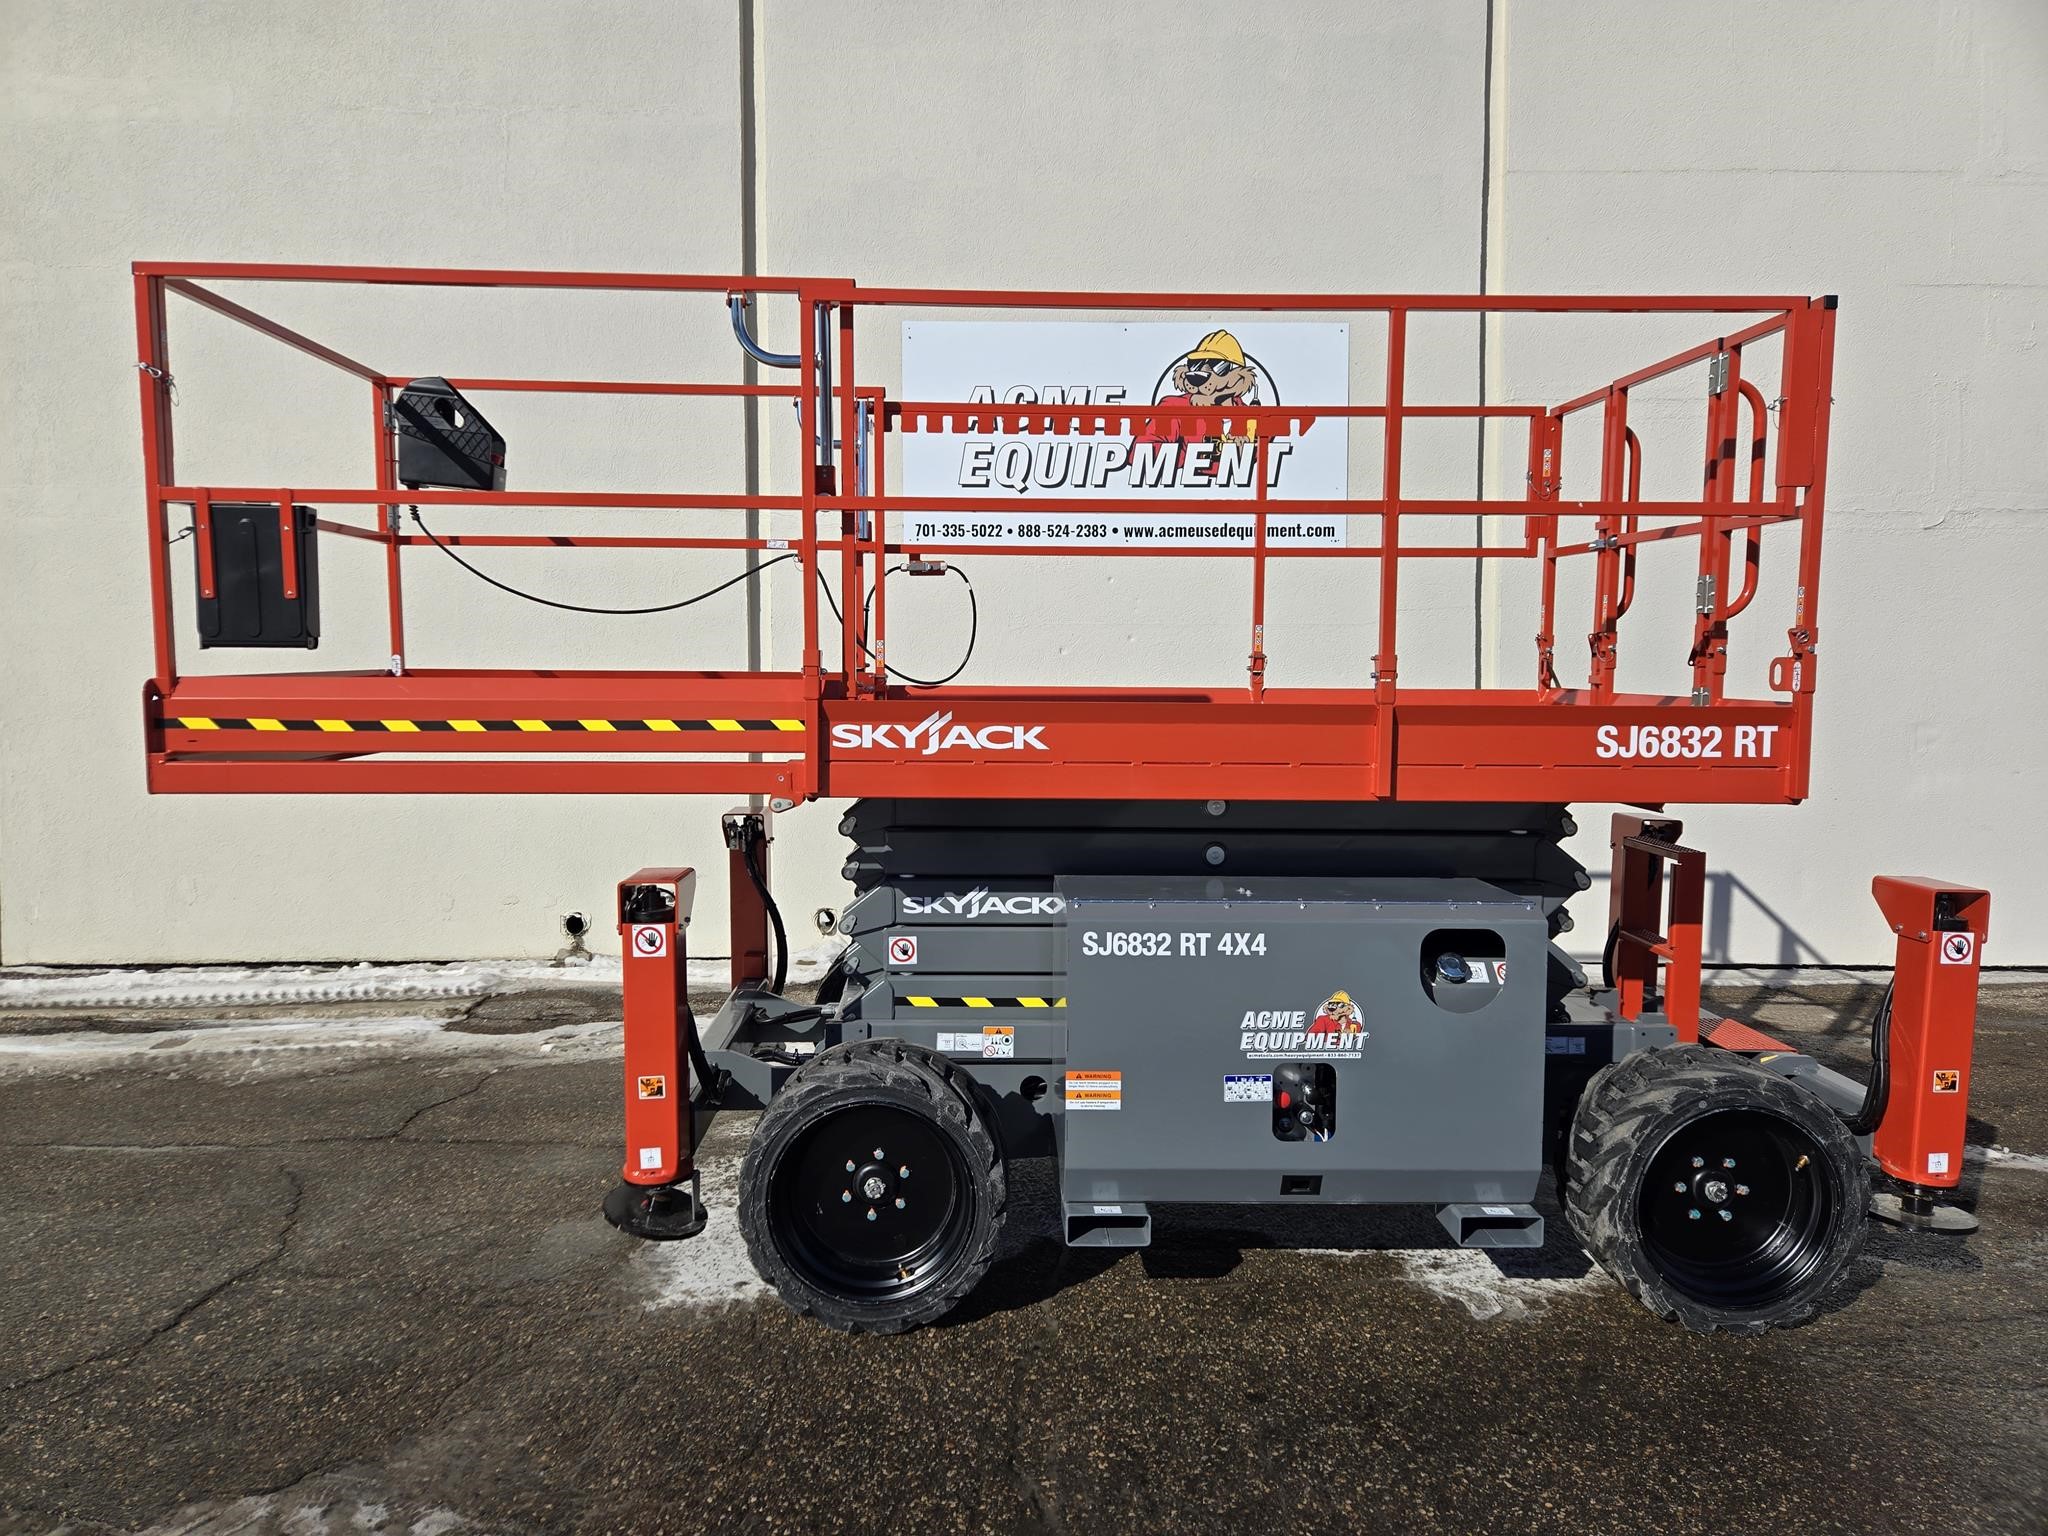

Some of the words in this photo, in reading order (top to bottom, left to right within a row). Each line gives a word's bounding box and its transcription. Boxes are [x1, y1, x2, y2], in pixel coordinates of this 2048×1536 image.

[958, 442, 1292, 493] EQUIPMENT
[915, 523, 1003, 538] 701-335-5022
[1017, 523, 1107, 538] 888-524-2383
[1124, 523, 1335, 540] www.acmeusedequiment.com
[832, 711, 1049, 755] SKYJACK
[1596, 725, 1722, 758] SJ6832
[1734, 725, 1778, 758] RT
[902, 886, 1058, 919] SKYJACK
[1082, 931, 1172, 956] SJ6832
[1180, 932, 1211, 956] RT
[1217, 932, 1267, 956] 4X4
[1240, 1010, 1306, 1030] ACME
[1240, 1031, 1370, 1052] EQUIPMENT
